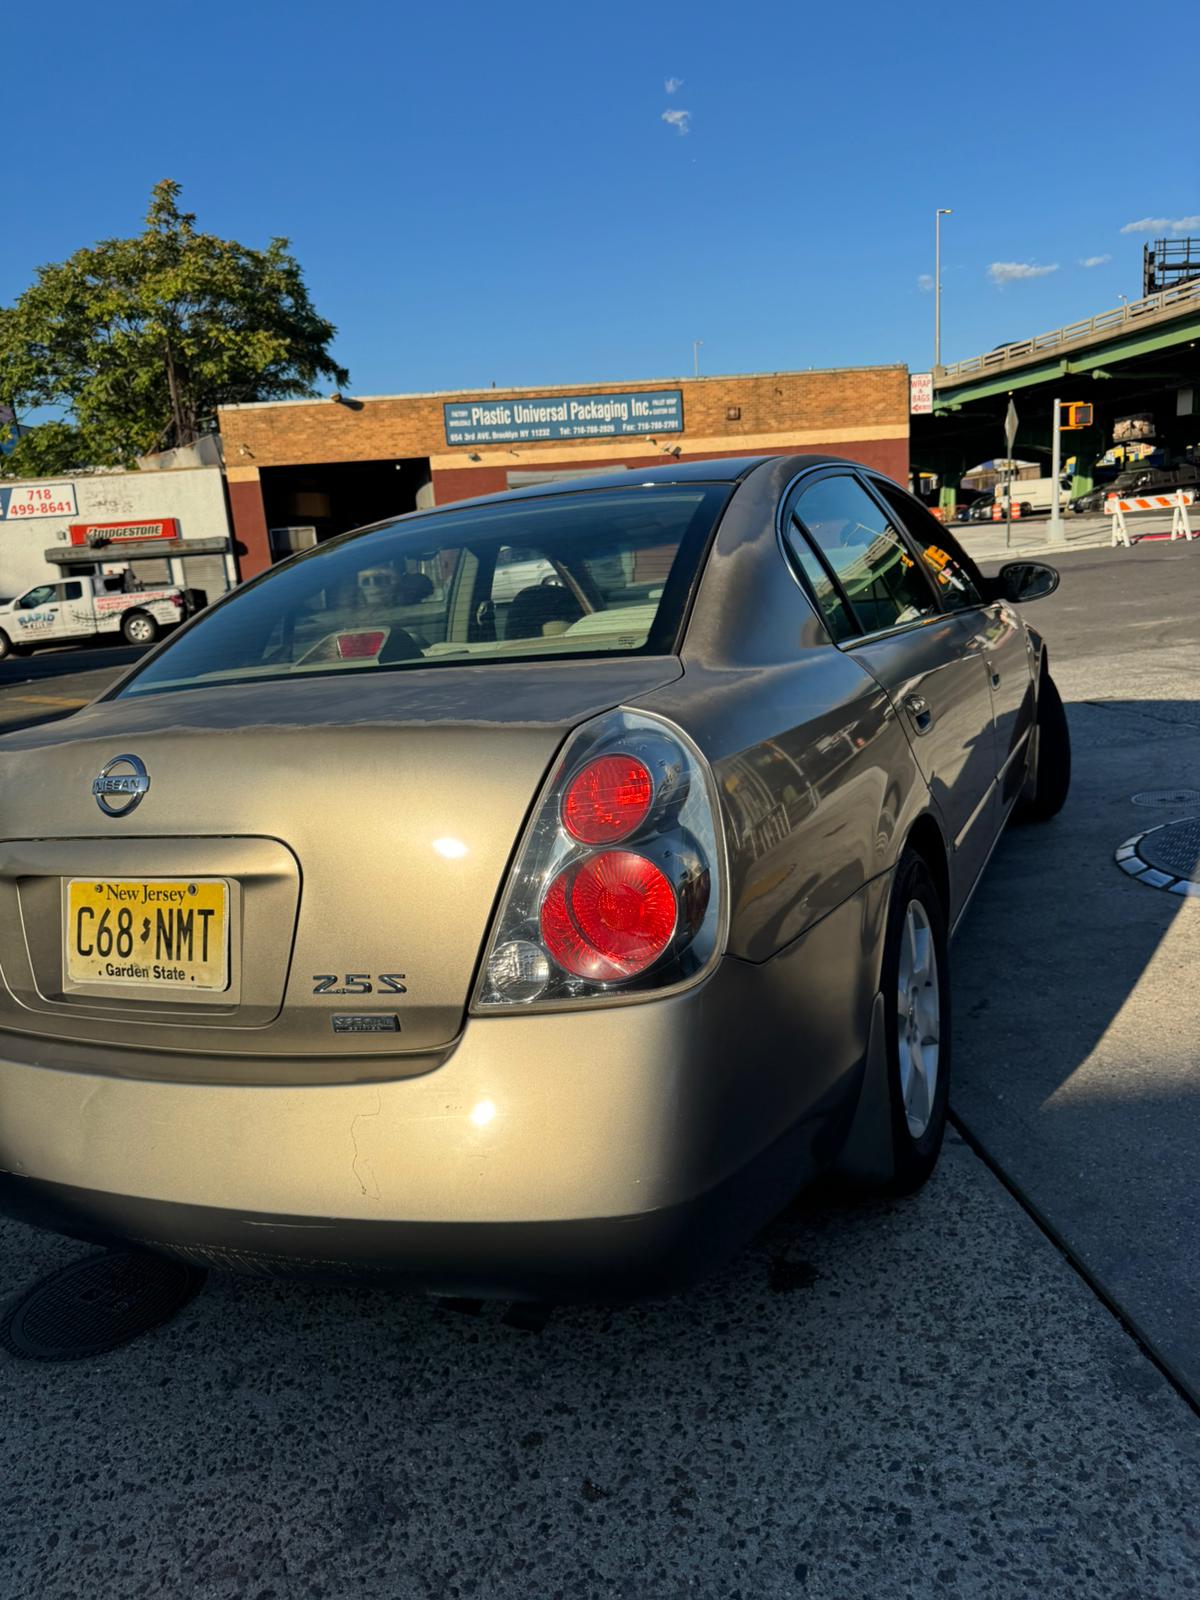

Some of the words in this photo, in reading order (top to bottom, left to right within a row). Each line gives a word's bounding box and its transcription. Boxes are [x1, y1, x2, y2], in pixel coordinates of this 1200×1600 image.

[471, 406, 511, 426] Plastic
[513, 402, 567, 424] Universal
[570, 400, 628, 422] Packaging
[631, 398, 653, 417] Inc.
[520, 429, 529, 438] NY
[27, 489, 51, 501] 718
[10, 501, 71, 515] 499-8641
[18, 610, 55, 626] RAPID
[95, 778, 140, 791] NISSAN
[106, 884, 140, 902] New
[141, 884, 186, 905] Jersey
[77, 906, 133, 958] C68
[156, 908, 215, 962] NMT
[105, 963, 149, 978] Garden
[153, 965, 185, 981] State
